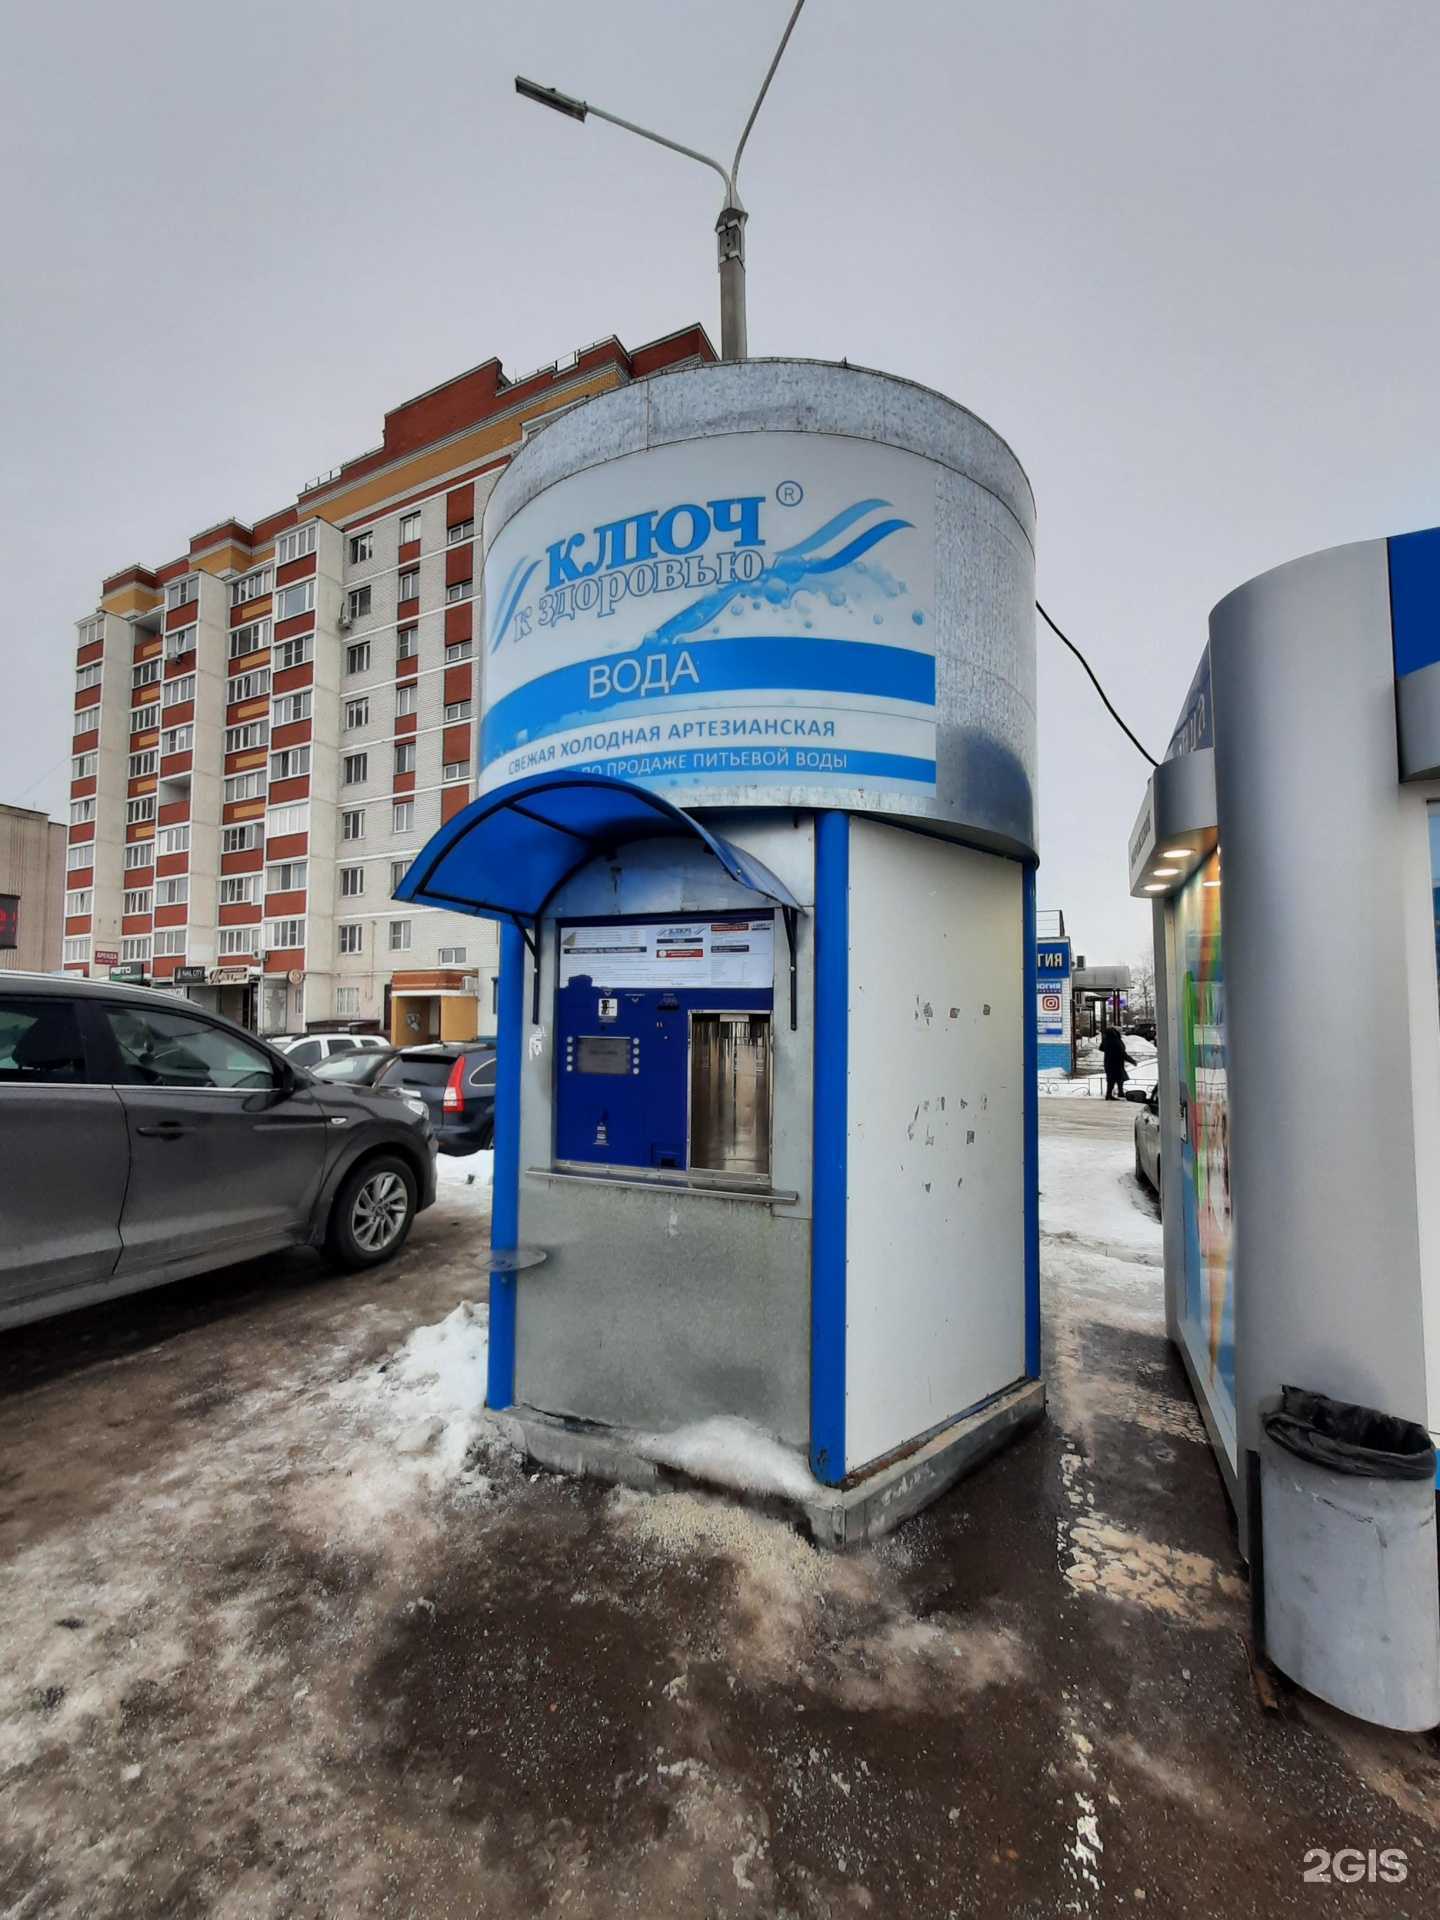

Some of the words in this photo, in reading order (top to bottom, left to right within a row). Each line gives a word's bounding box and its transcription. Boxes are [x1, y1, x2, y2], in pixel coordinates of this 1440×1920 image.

[588, 650, 699, 699] ВОДА
[508, 745, 556, 776] СВЕЖАЯ
[560, 725, 661, 757] ХОЛОДНАЯ
[668, 718, 835, 740] АРТЕЗИАНСКАЯ
[607, 753, 688, 777] ПРОДАЖЕ
[693, 748, 789, 769] ПИТЬЕВОЙ
[796, 751, 847, 771] ВОДЫ
